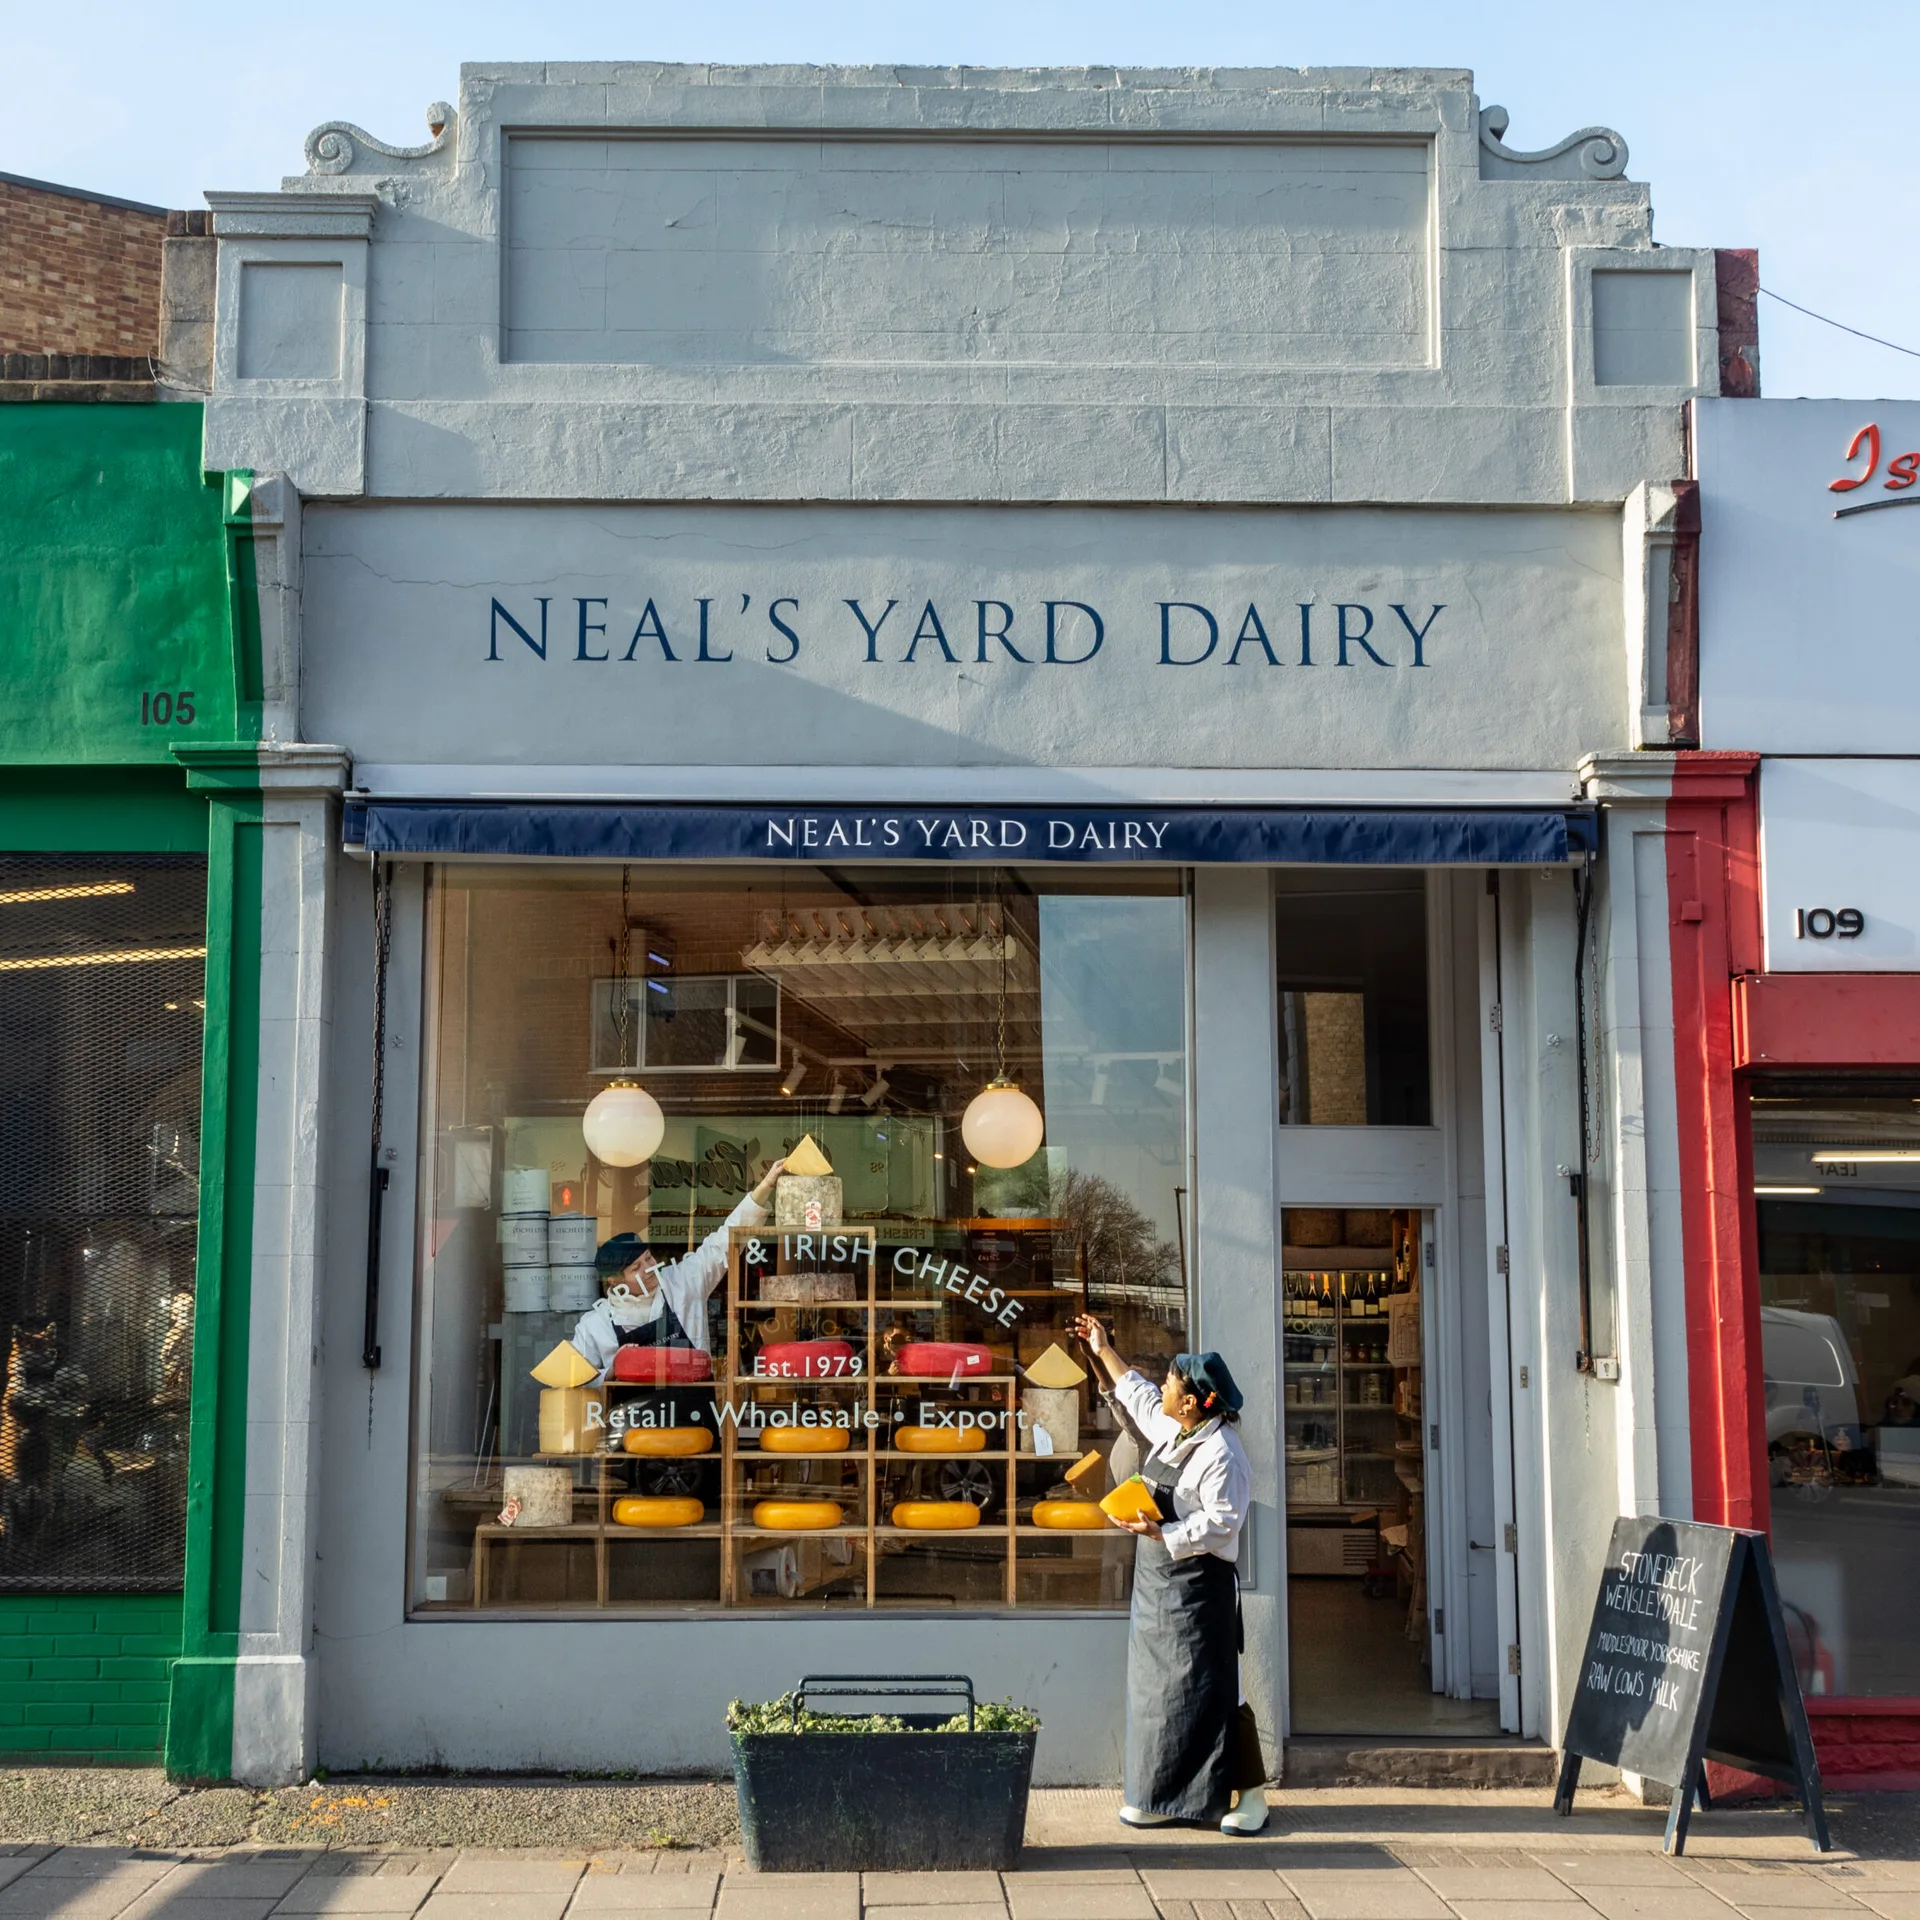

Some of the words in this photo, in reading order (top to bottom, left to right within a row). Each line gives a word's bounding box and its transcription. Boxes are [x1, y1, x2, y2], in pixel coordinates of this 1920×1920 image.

[484, 594, 800, 663] NEAL'S
[842, 598, 1105, 664] YARD
[1155, 601, 1448, 667] DAIRY
[141, 692, 196, 725] 105
[766, 818, 900, 847] NEAL'S
[917, 819, 1027, 848] YARD
[1047, 821, 1170, 849] DAIRY
[1795, 908, 1865, 939] 109
[745, 1237, 769, 1264] &
[784, 1234, 877, 1266] IRISH
[893, 1247, 1025, 1328] CHEESE
[585, 1401, 675, 1429] Retail
[709, 1401, 880, 1429] Wholesale
[919, 1401, 1028, 1438] Export
[1618, 1551, 1703, 1595] STONEBECK
[1605, 1584, 1703, 1631] WENSLEYDALE
[1650, 1642, 1701, 1673] YORKSHIRE
[1586, 1661, 1613, 1693] RAW
[1648, 1676, 1680, 1712] MILK
